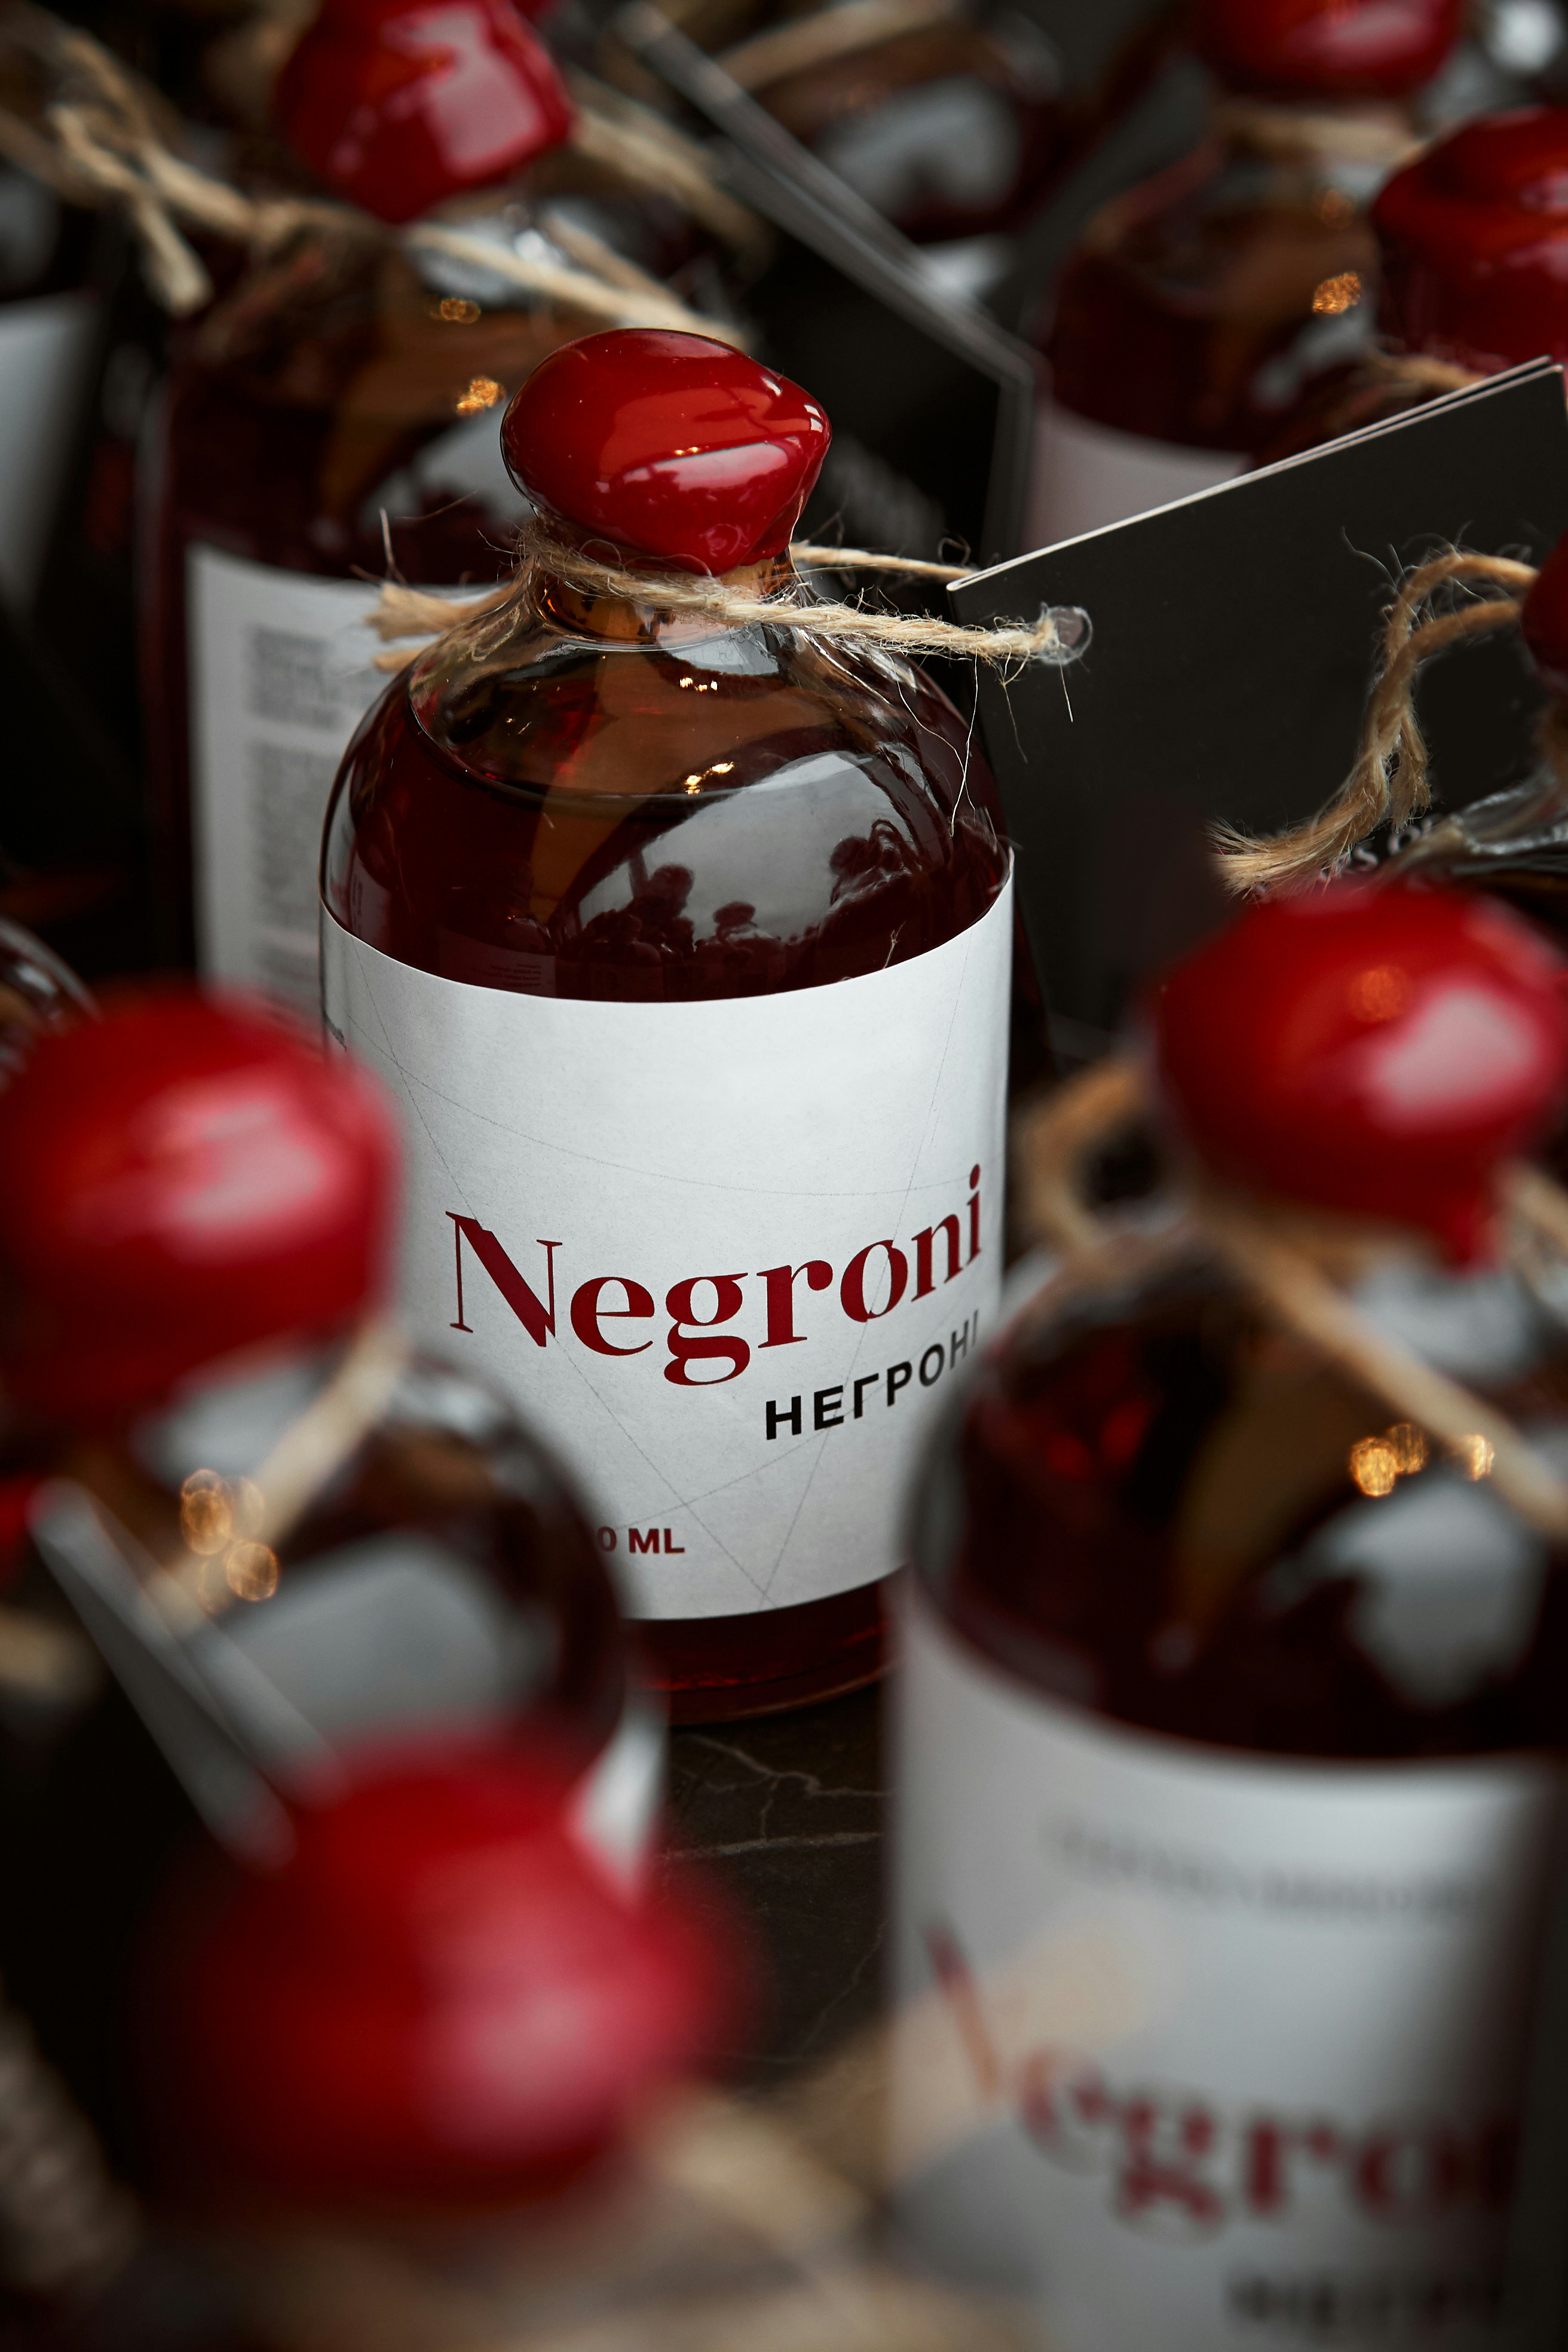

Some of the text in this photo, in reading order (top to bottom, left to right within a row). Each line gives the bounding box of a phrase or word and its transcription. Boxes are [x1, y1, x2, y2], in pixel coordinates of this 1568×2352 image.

[445, 1163, 982, 1386] Negroni
[598, 1526, 685, 1554] 0 ML
